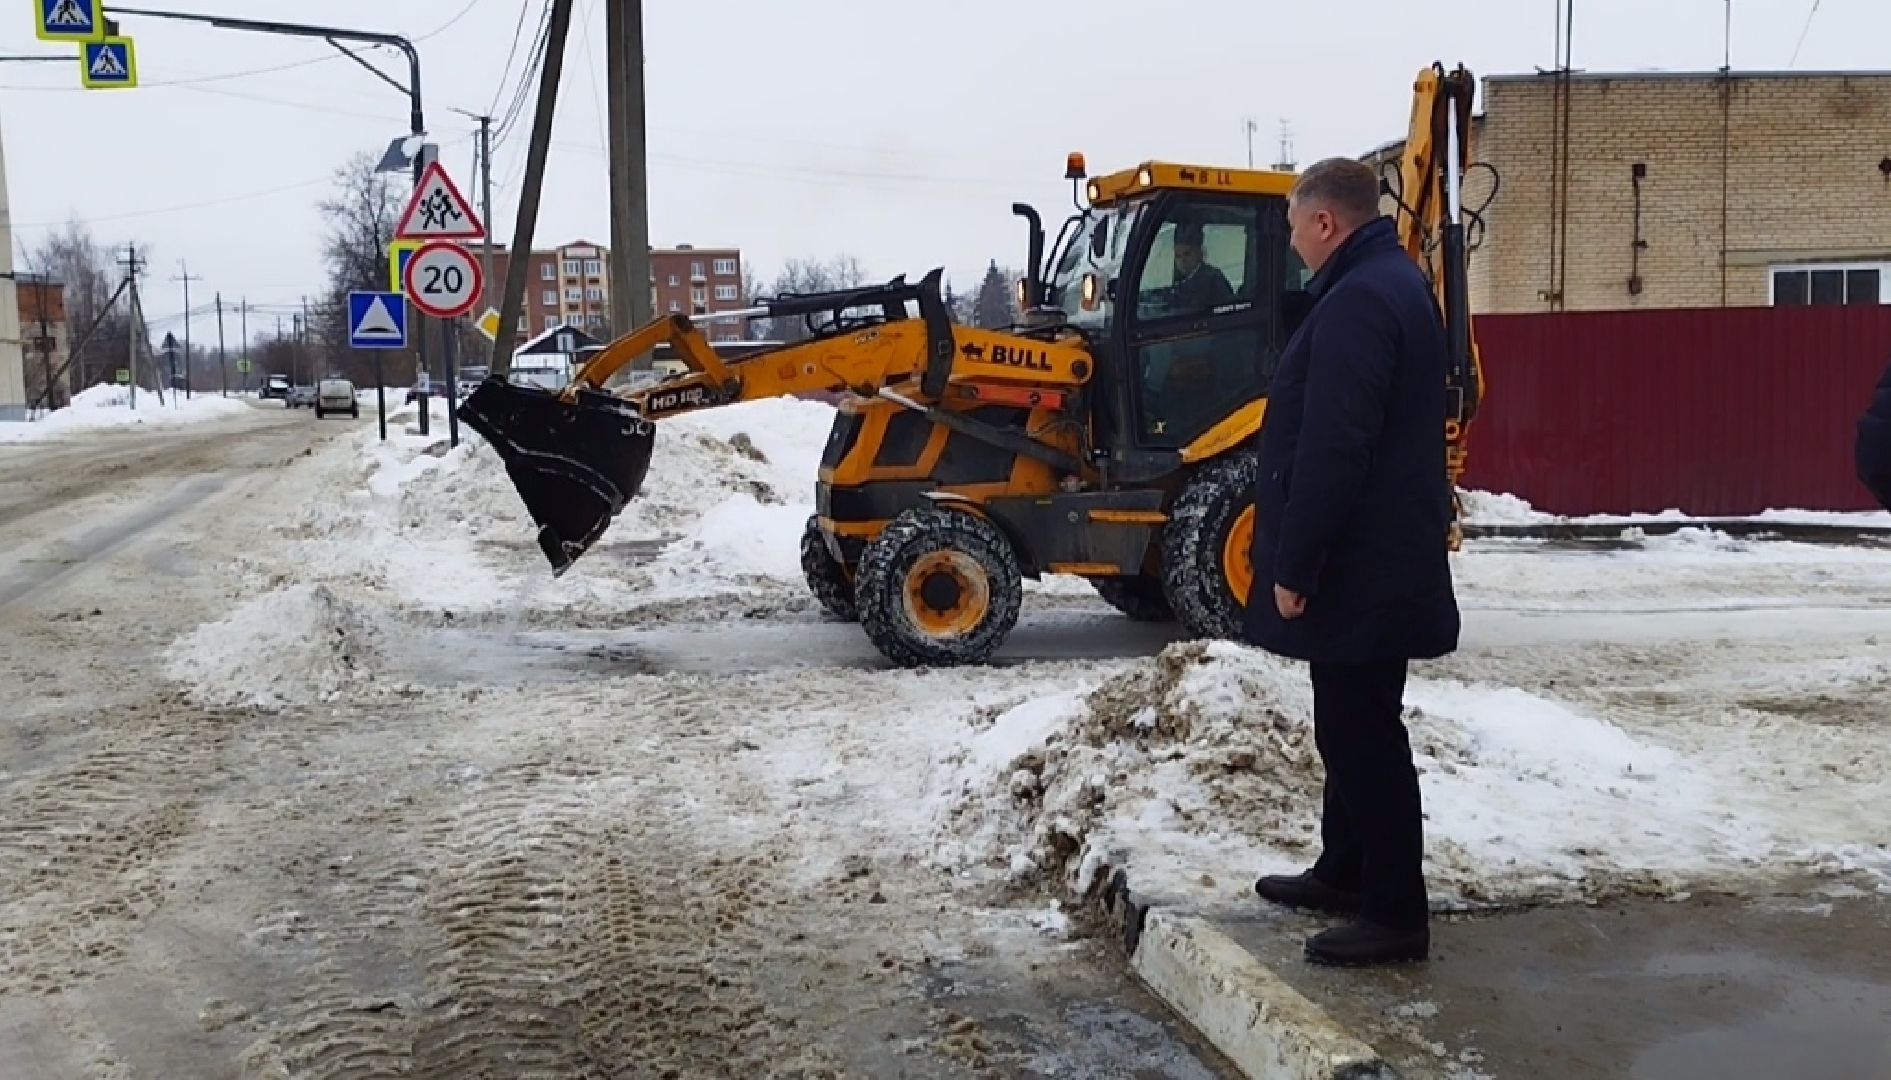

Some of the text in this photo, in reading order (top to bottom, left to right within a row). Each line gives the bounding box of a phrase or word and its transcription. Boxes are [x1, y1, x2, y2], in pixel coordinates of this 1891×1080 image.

[1200, 169, 1231, 185] BLL
[424, 265, 463, 294] 20
[992, 344, 1053, 373] BULL
[652, 394, 677, 410] HD
